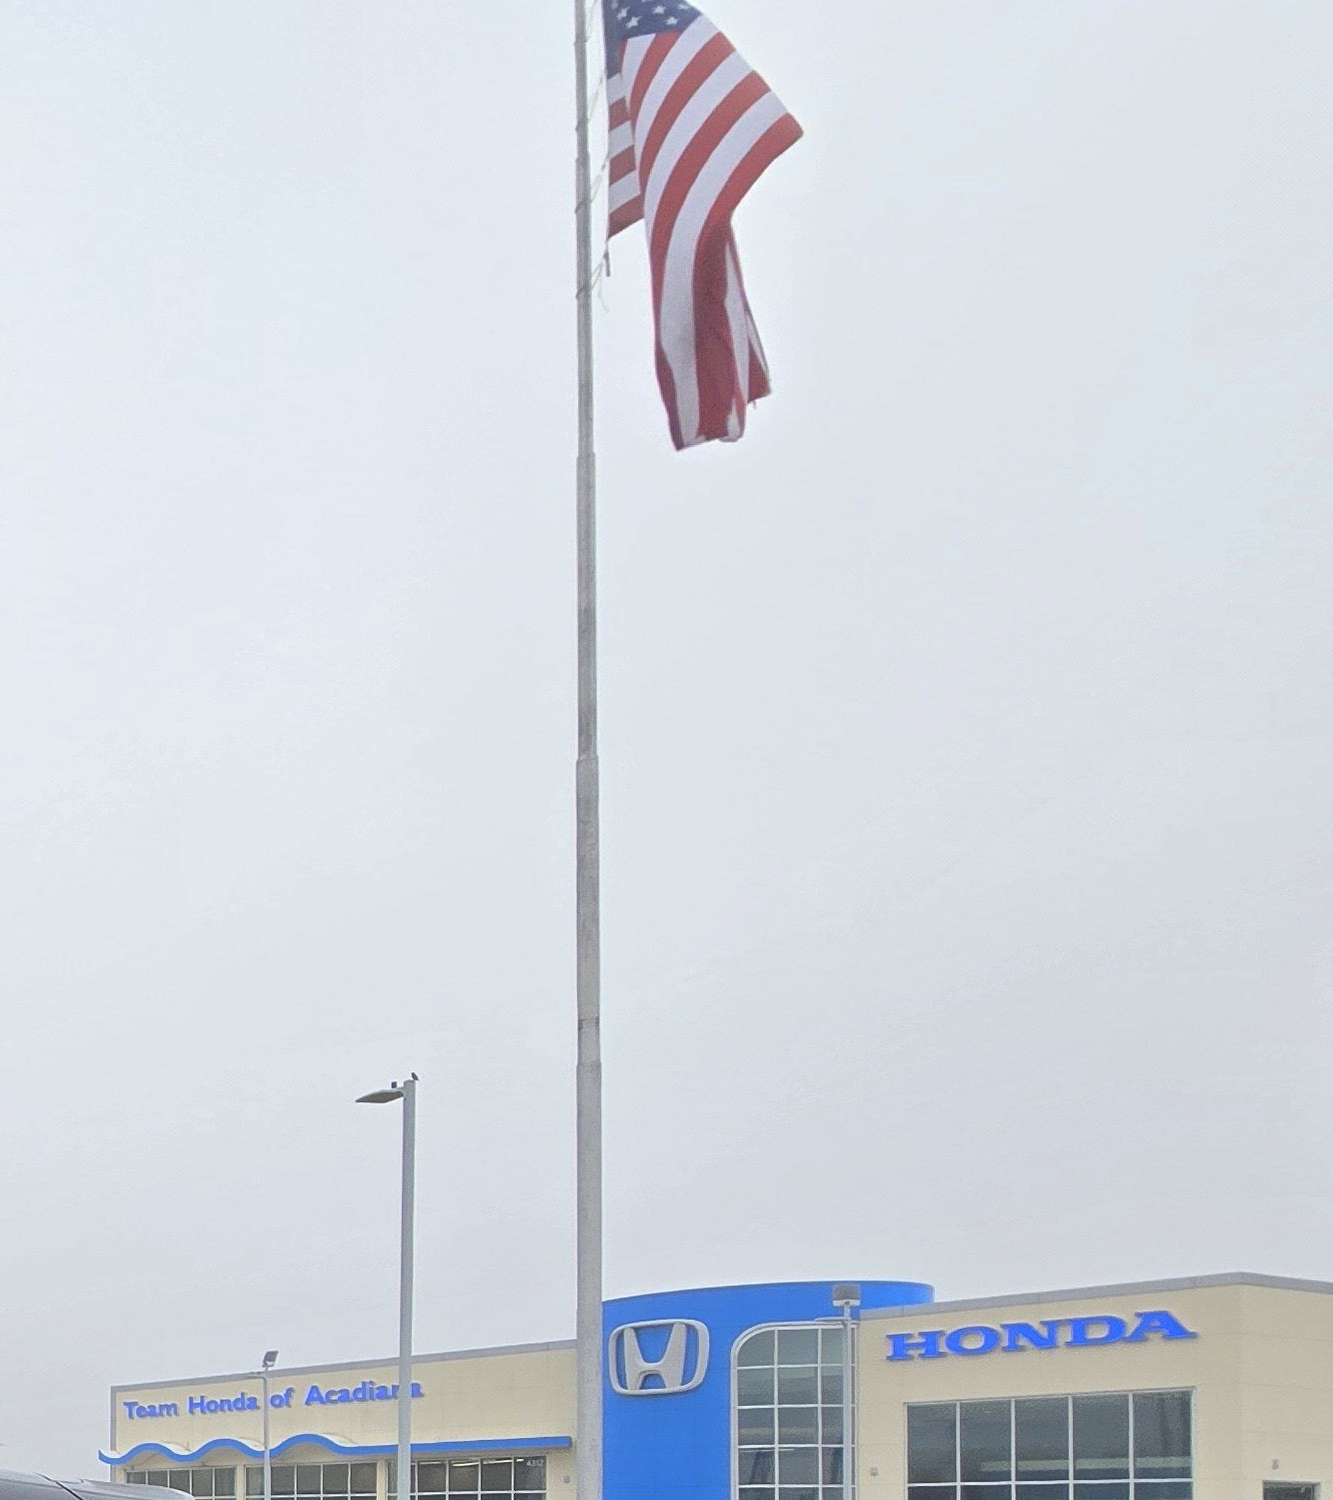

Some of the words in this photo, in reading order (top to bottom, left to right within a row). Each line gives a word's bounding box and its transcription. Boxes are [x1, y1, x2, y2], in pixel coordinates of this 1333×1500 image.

[885, 1310, 1199, 1362] HONDA
[123, 1401, 179, 1420] Team
[188, 1391, 260, 1415] Honda
[270, 1386, 294, 1409] of
